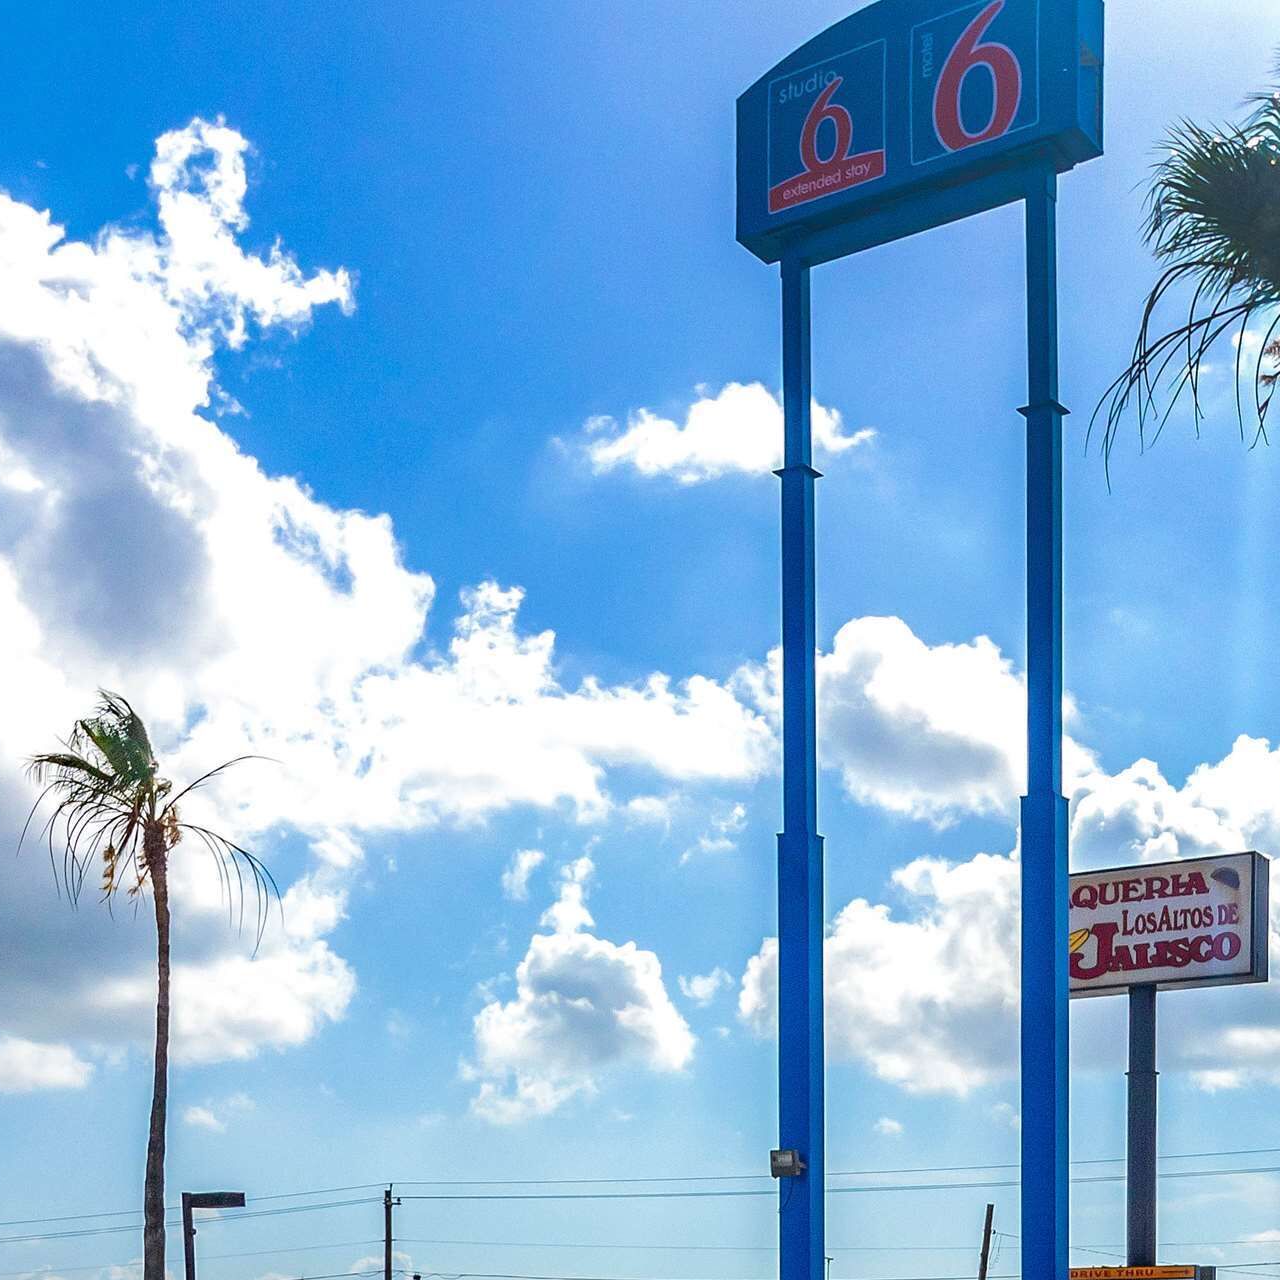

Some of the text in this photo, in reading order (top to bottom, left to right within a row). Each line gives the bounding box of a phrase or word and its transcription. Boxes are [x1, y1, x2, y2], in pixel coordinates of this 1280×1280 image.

[921, 32, 934, 78] motel
[778, 69, 838, 104] studio
[933, 0, 1022, 153] 6
[799, 76, 854, 173] 6
[782, 161, 872, 202] extended stay
[1070, 871, 1209, 910] QUERIA
[1217, 902, 1239, 926] DE
[1070, 921, 1242, 980] JALISCO
[1070, 1269, 1154, 1278] DRIVE THRU
